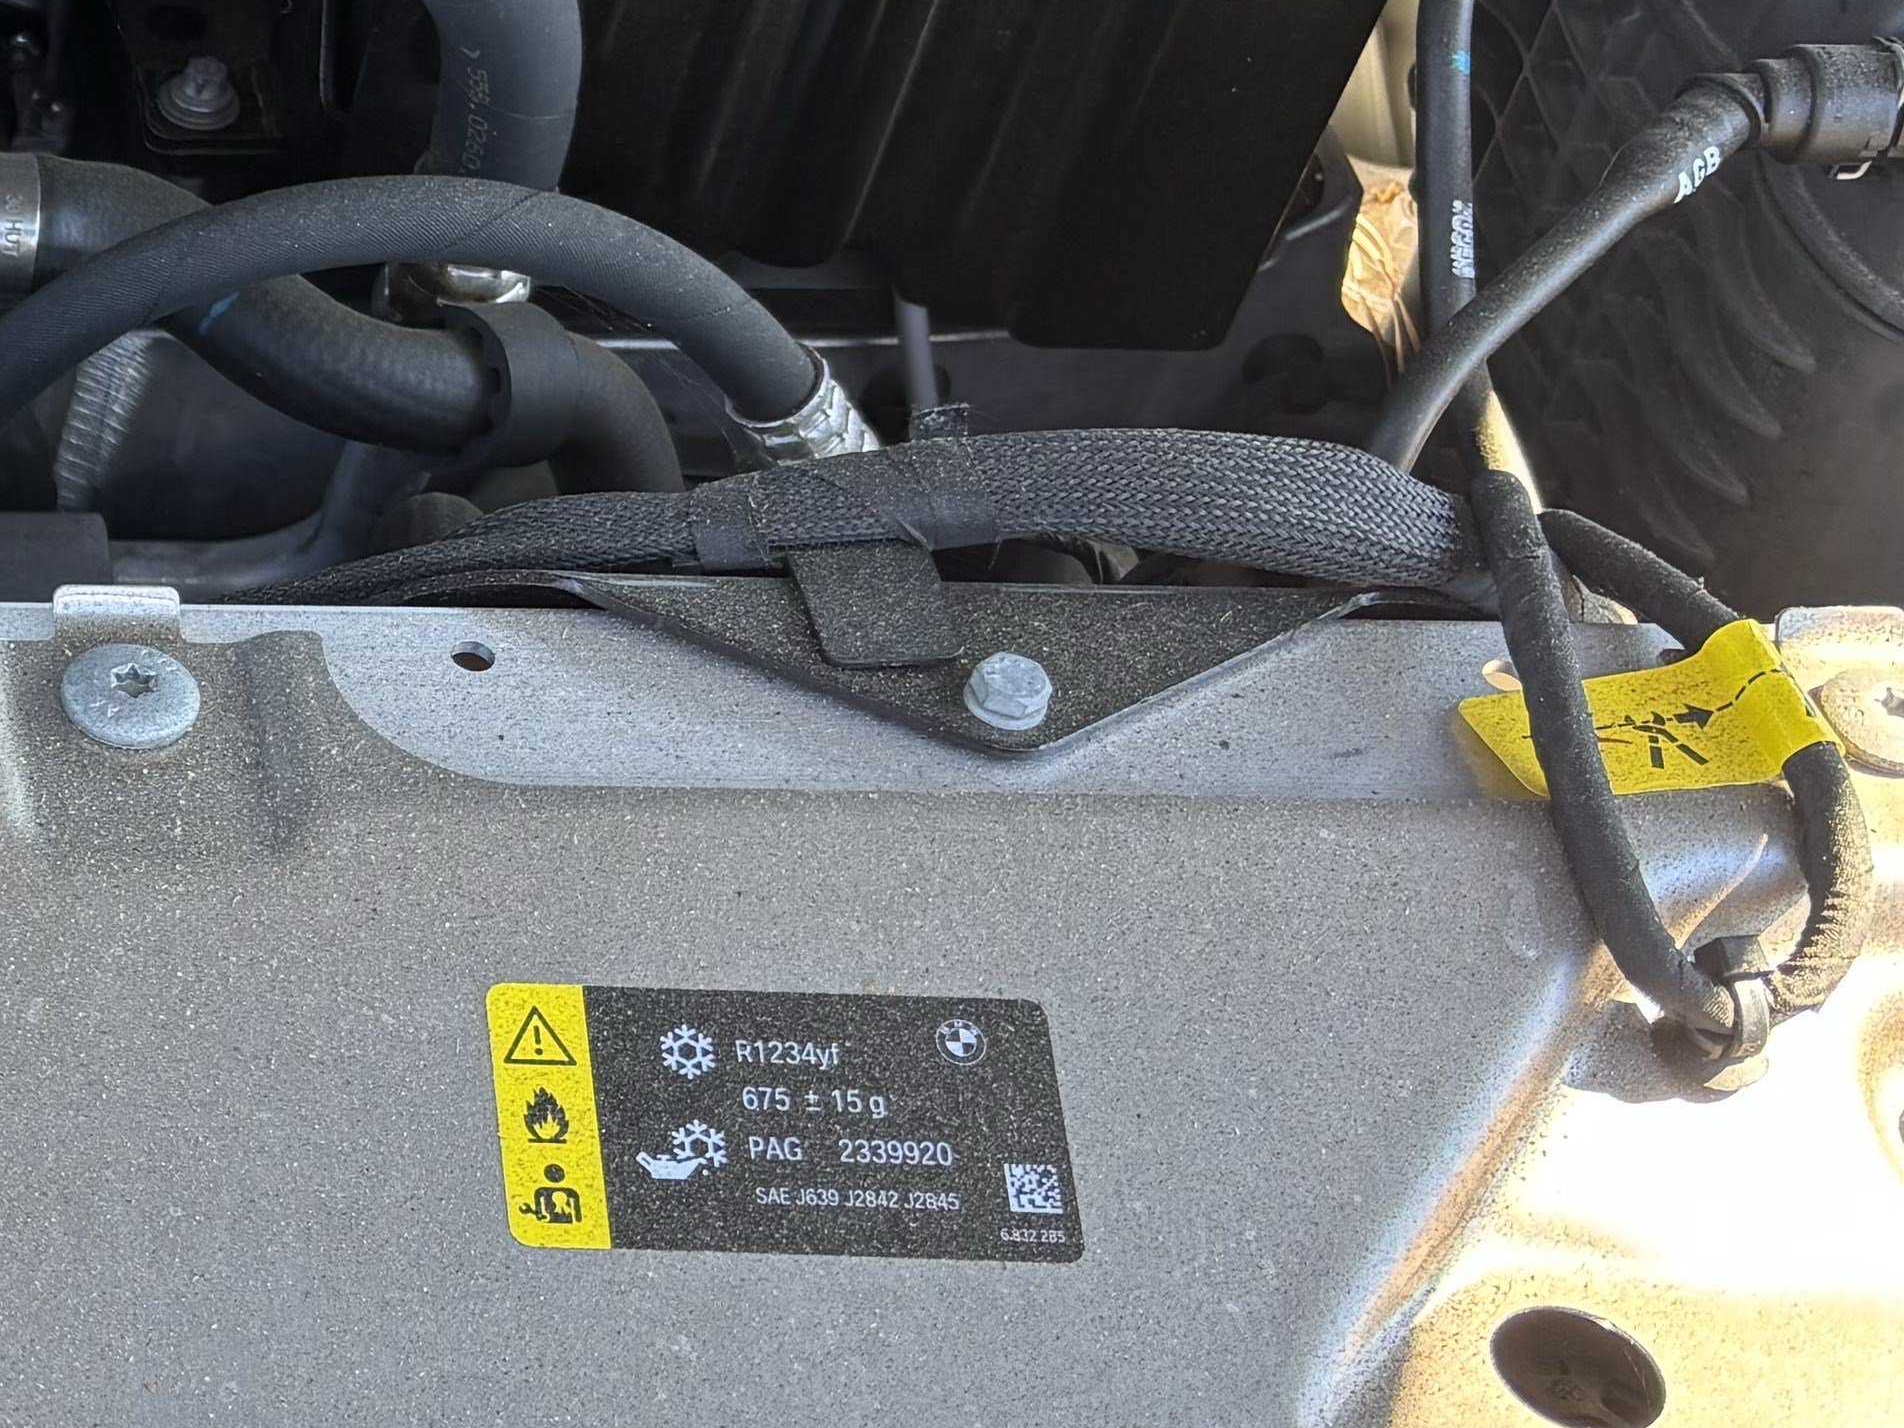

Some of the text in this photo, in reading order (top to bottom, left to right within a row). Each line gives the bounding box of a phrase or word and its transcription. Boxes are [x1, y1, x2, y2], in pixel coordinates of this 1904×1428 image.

[1674, 144, 1724, 206] AGB
[736, 1039, 840, 1071] R1234yf
[742, 1086, 886, 1118] 675 ± 15 g
[749, 1137, 953, 1166] PAG 2339920
[755, 1187, 961, 1211] SAE J639 J2842 J2845
